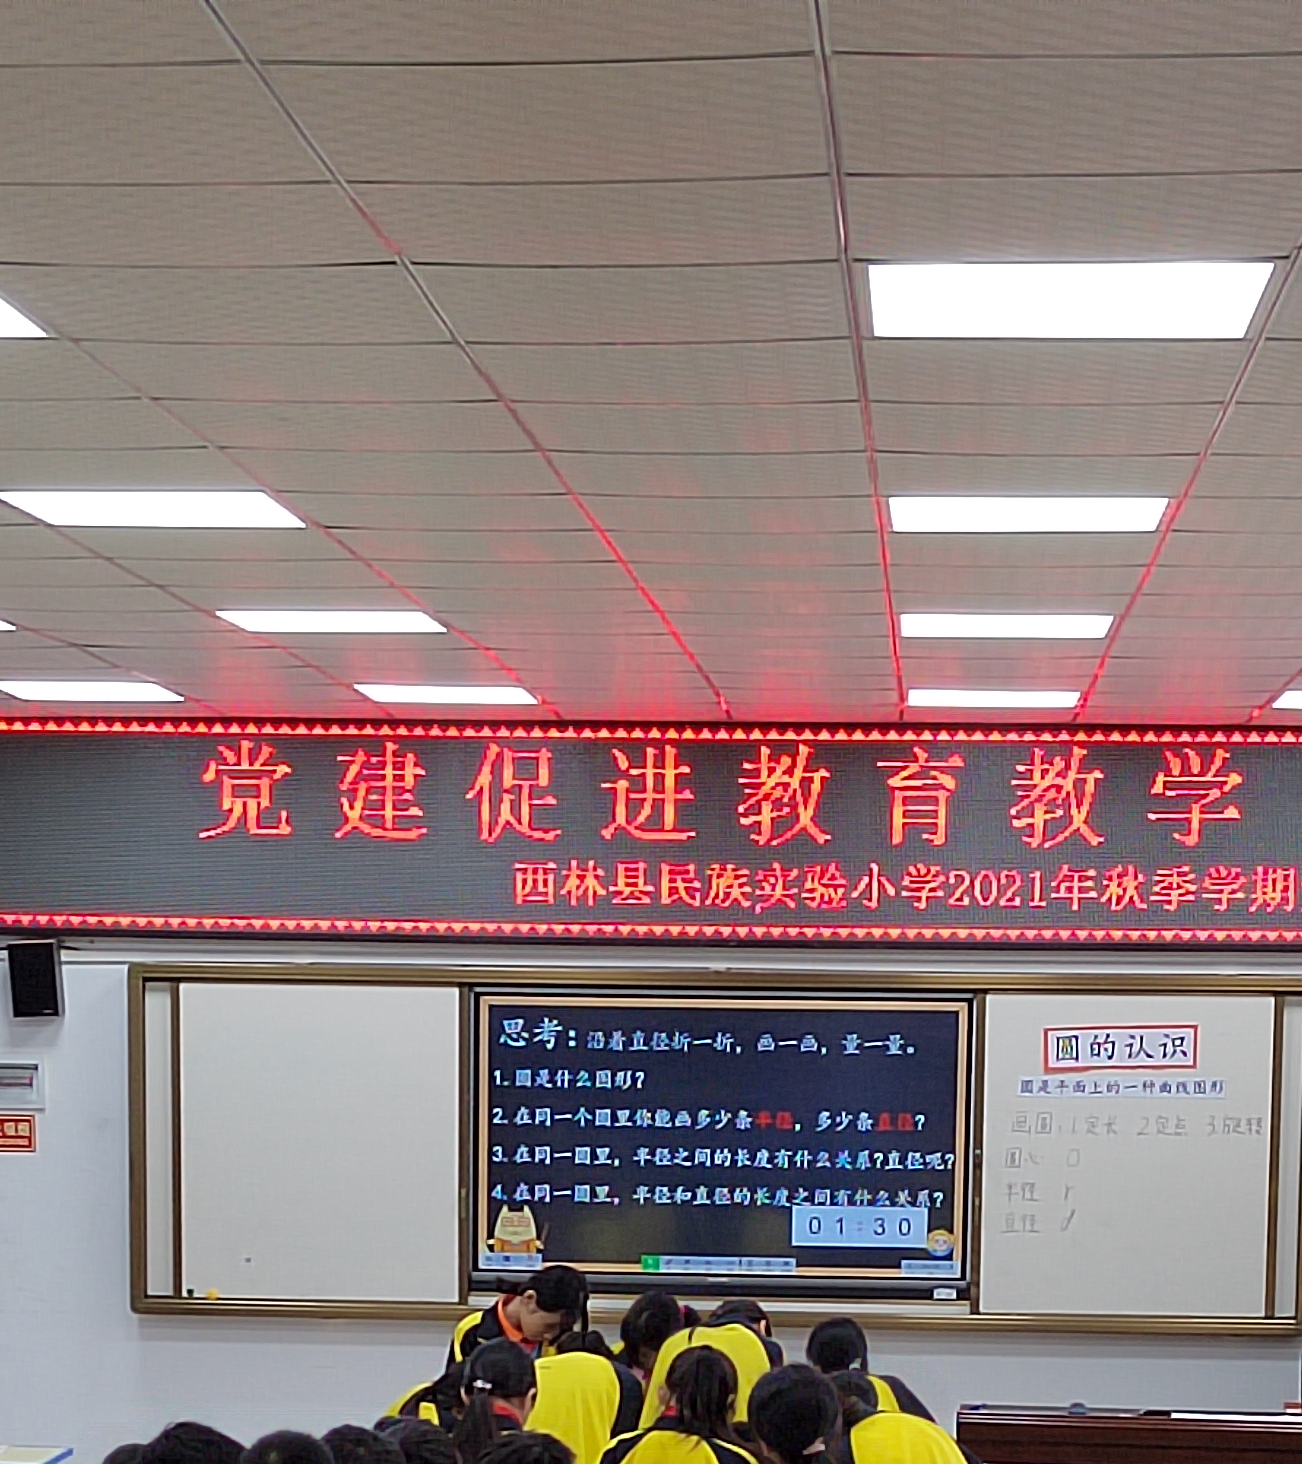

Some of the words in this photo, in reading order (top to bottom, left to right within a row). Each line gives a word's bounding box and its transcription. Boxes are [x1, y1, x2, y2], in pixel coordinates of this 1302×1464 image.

[197, 739, 1243, 849] 党建促进教育教学
[1055, 1034, 1189, 1063] 圆的认识
[1020, 1079, 1223, 1096] 圆是平面上的一种曲线图形
